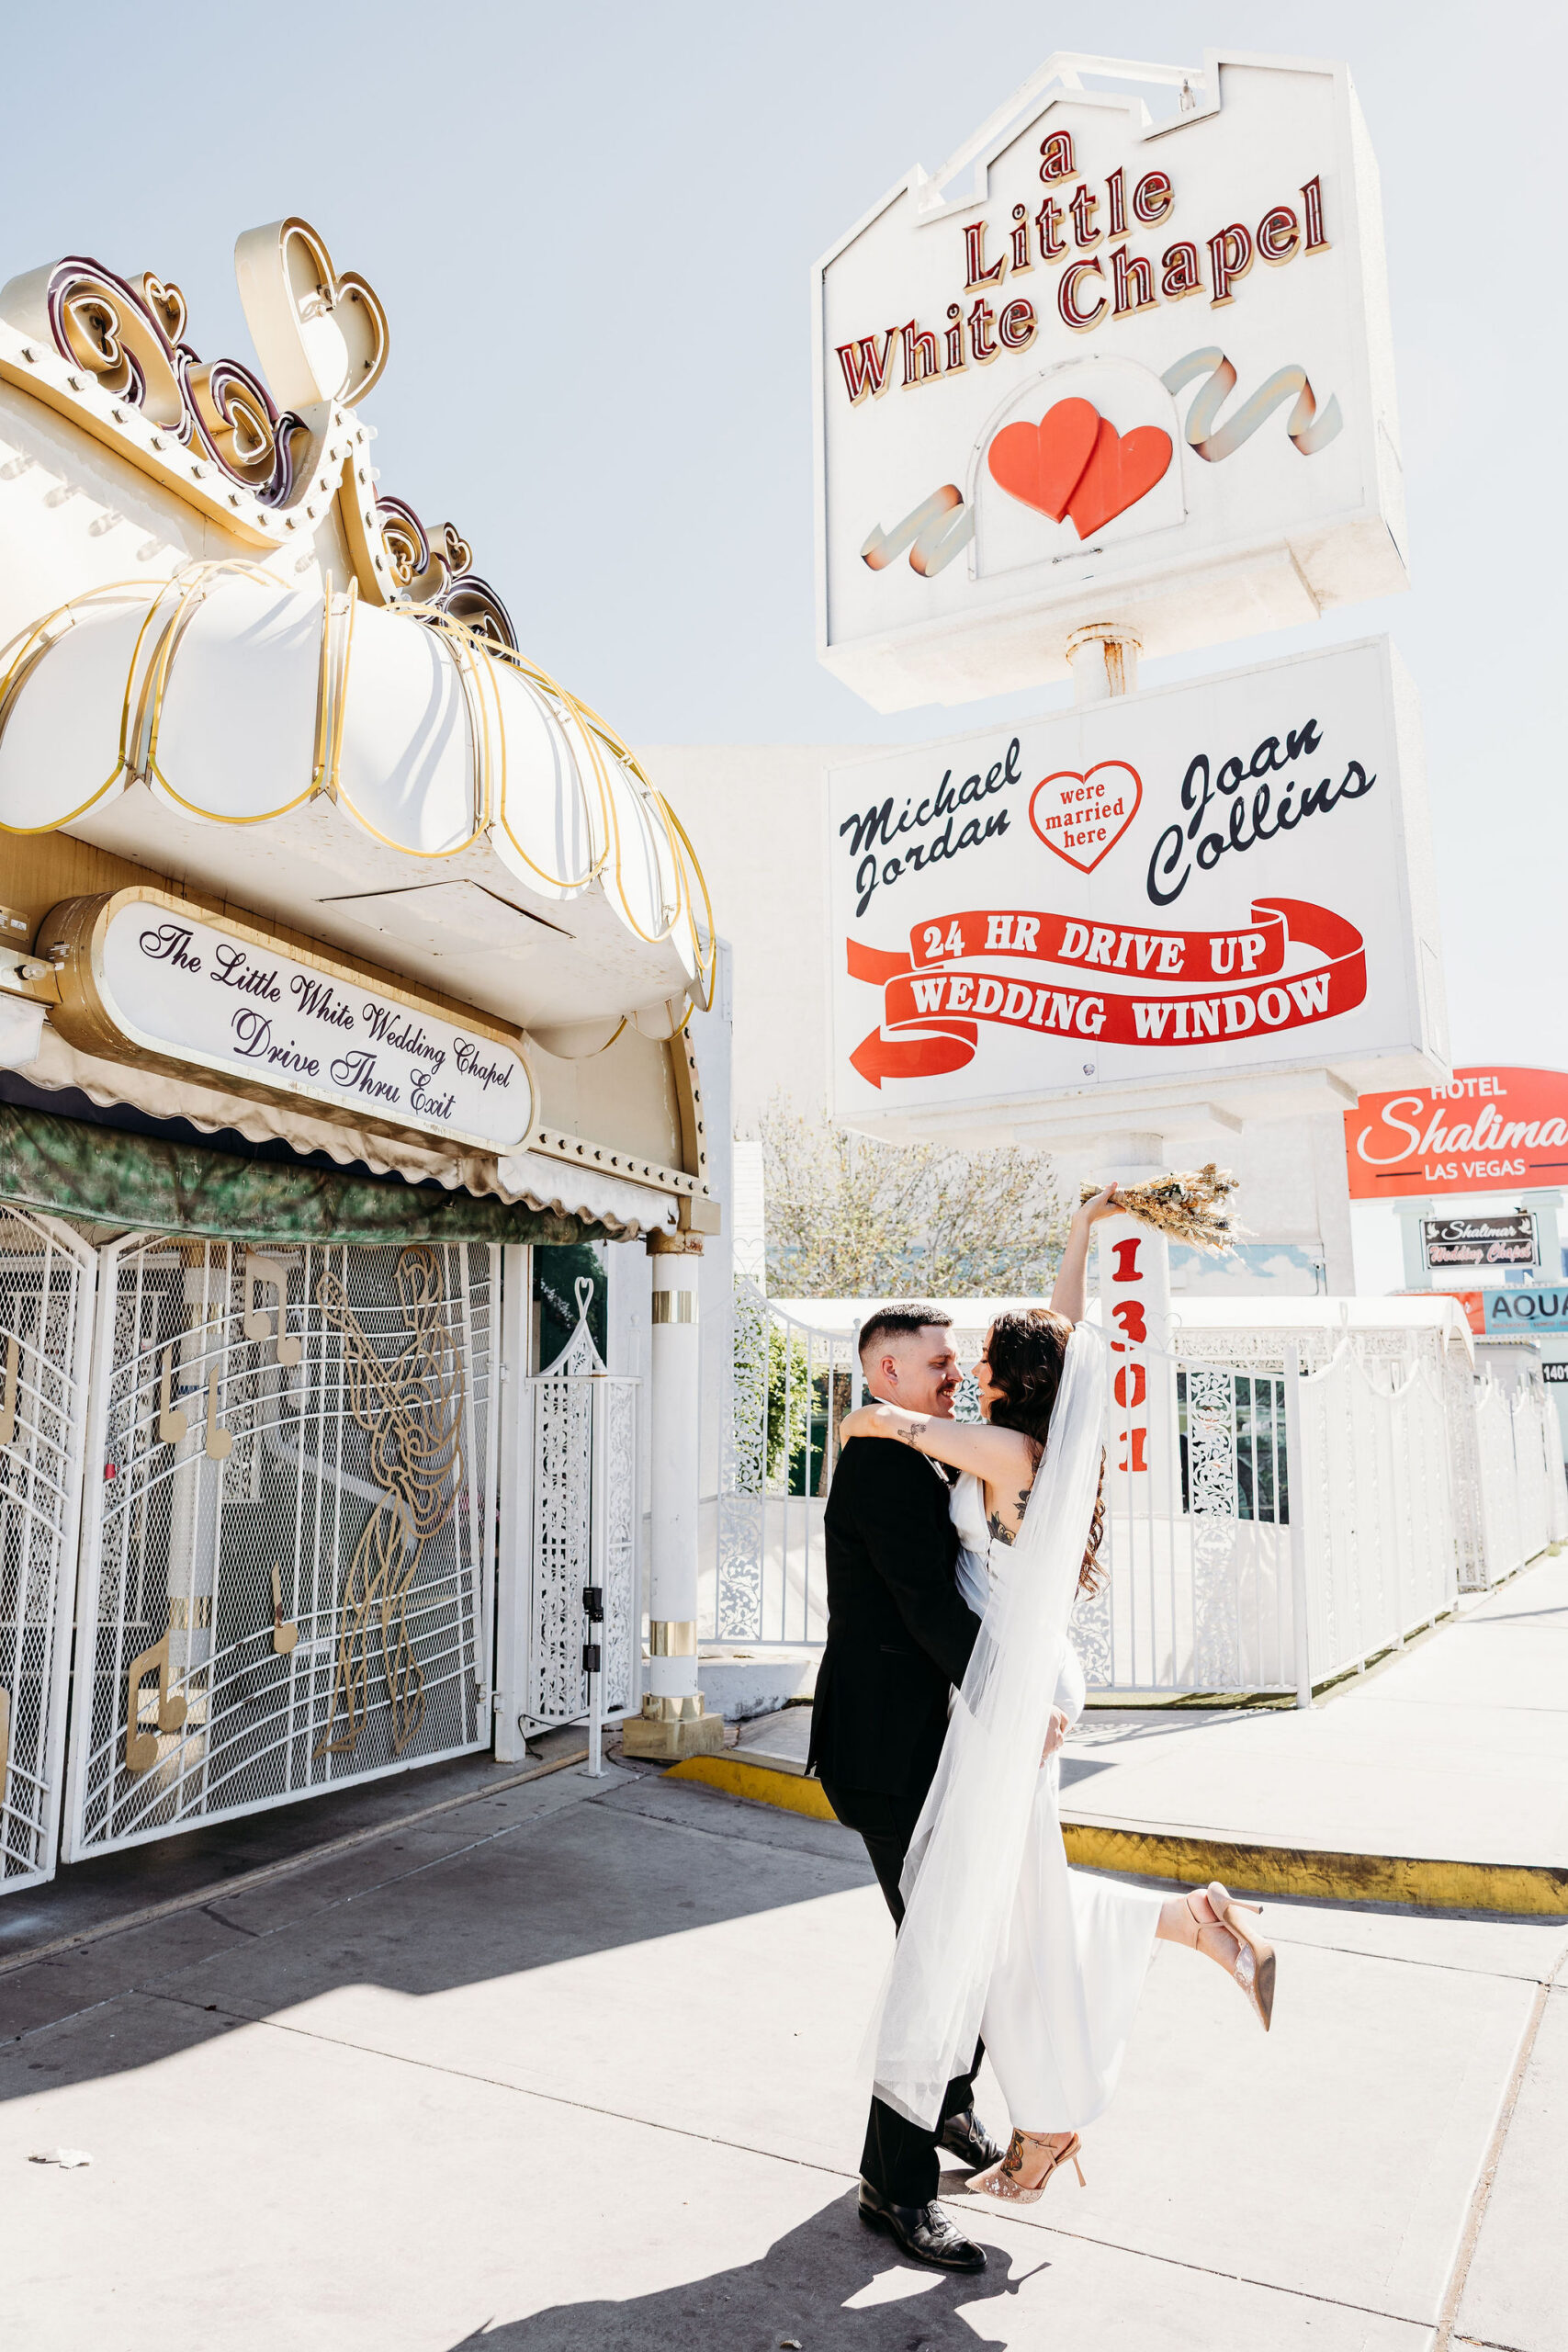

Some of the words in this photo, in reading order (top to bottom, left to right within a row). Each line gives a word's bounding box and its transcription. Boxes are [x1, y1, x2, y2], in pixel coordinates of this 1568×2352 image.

[1039, 130, 1080, 188] a
[962, 166, 1175, 294] Little
[834, 298, 1037, 407] White
[1057, 175, 1332, 334] Chapel
[840, 737, 1022, 856] Michael
[1059, 783, 1106, 806] were
[1180, 718, 1324, 841] Joan
[1044, 797, 1125, 831] married
[1063, 825, 1107, 849] here
[1146, 760, 1377, 906] Collins
[855, 808, 1010, 918] Jordan
[923, 920, 965, 959] 24
[985, 915, 1041, 953] HR
[1057, 923, 1186, 974] DRIVE
[1209, 933, 1267, 974] UP
[139, 923, 201, 973] The
[210, 944, 281, 1002] Little
[289, 975, 355, 1030] White
[363, 1002, 446, 1075] Wedding
[453, 1037, 514, 1091] Chapel
[910, 978, 1107, 1036] WEDDING
[1132, 972, 1332, 1040] WINDOW
[231, 1008, 320, 1077] Drive
[330, 1049, 400, 1103] Thru
[411, 1069, 457, 1120] Exit
[1430, 1076, 1507, 1100] HOTEL
[1357, 1096, 1568, 1165] Shalima
[1425, 1162, 1458, 1181] LAS
[1462, 1159, 1526, 1179] VEGAS
[1429, 1245, 1483, 1265] Wedding
[1487, 1242, 1532, 1262] Chapel
[1441, 1221, 1517, 1240] Shalimar
[1110, 1238, 1147, 1472] 1301
